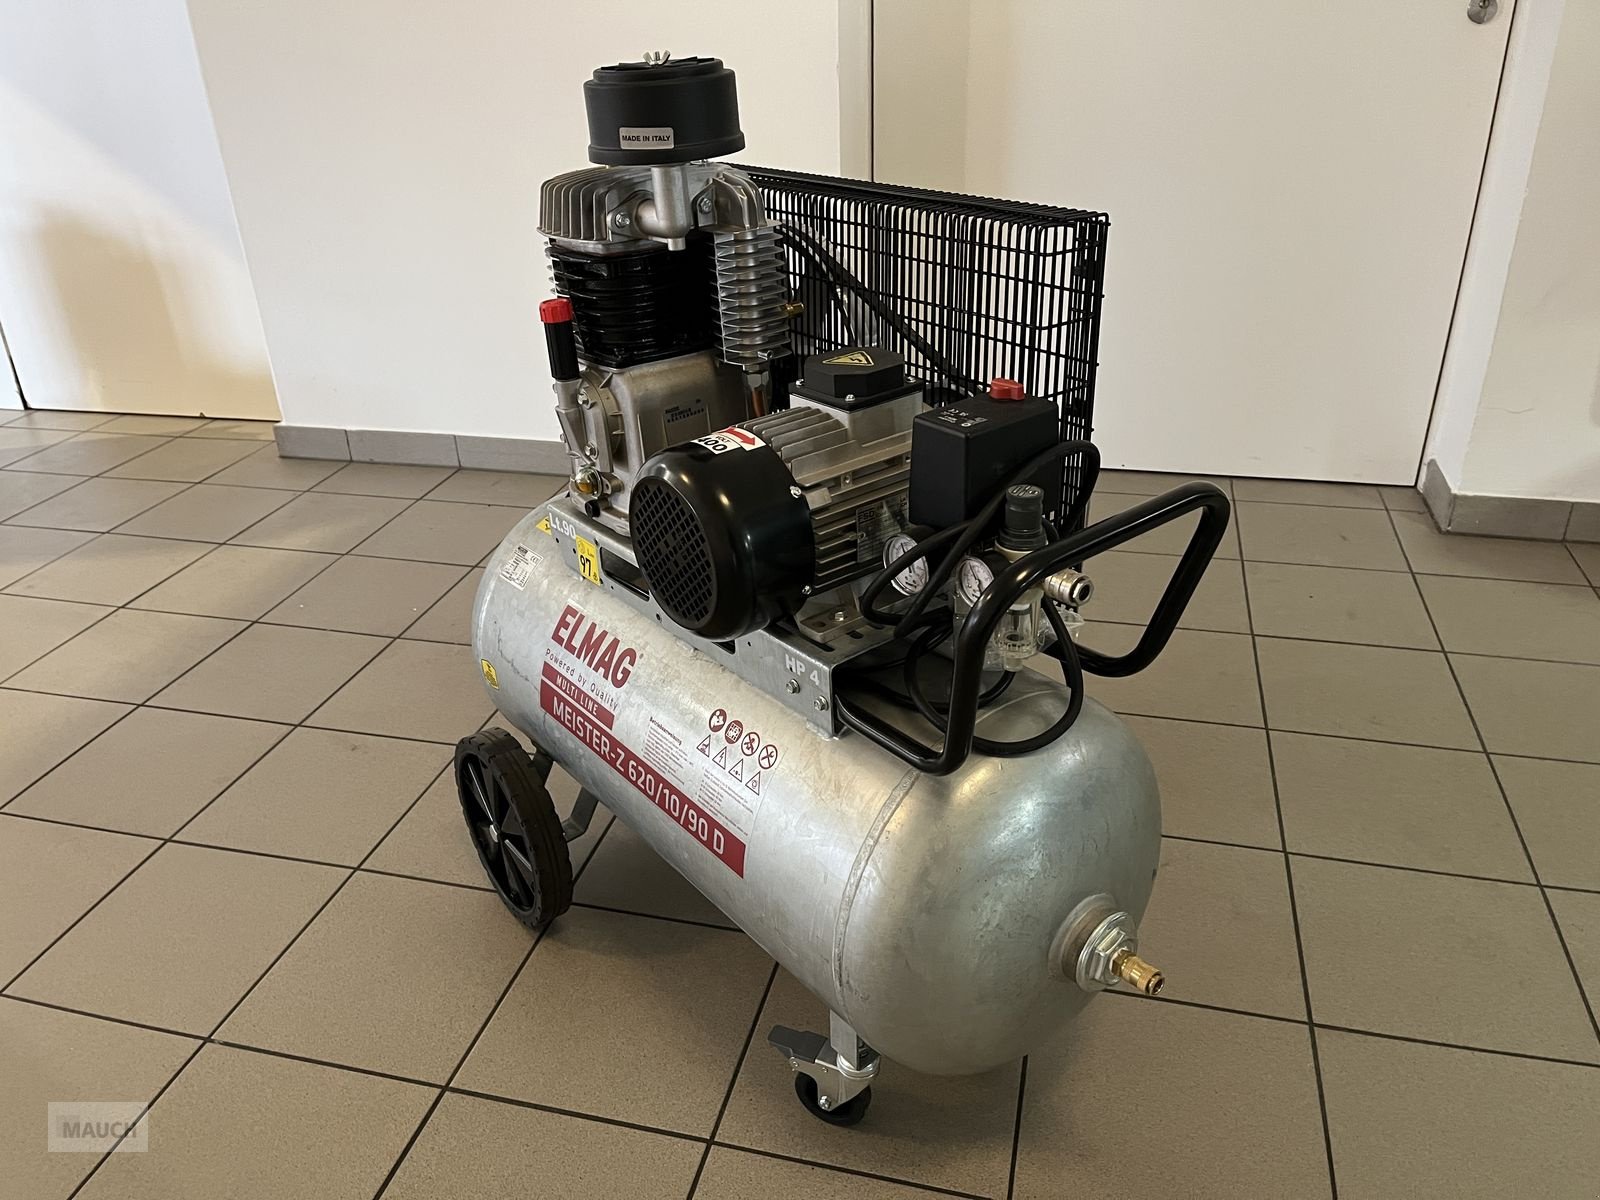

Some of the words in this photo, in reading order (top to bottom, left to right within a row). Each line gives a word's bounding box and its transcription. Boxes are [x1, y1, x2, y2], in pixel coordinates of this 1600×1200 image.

[548, 512, 577, 540] Lt.90
[579, 554, 592, 577] 97
[551, 604, 638, 689] ELMAG
[545, 648, 576, 677] Powered
[577, 673, 588, 688] by
[590, 682, 619, 711] Quality
[785, 653, 806, 676] HP
[809, 669, 820, 686] 4
[555, 674, 579, 699] MULTI
[580, 694, 599, 717] LINE
[552, 696, 626, 773] MEISTER-Z
[627, 759, 709, 842] 620/10/90
[712, 827, 726, 855] D
